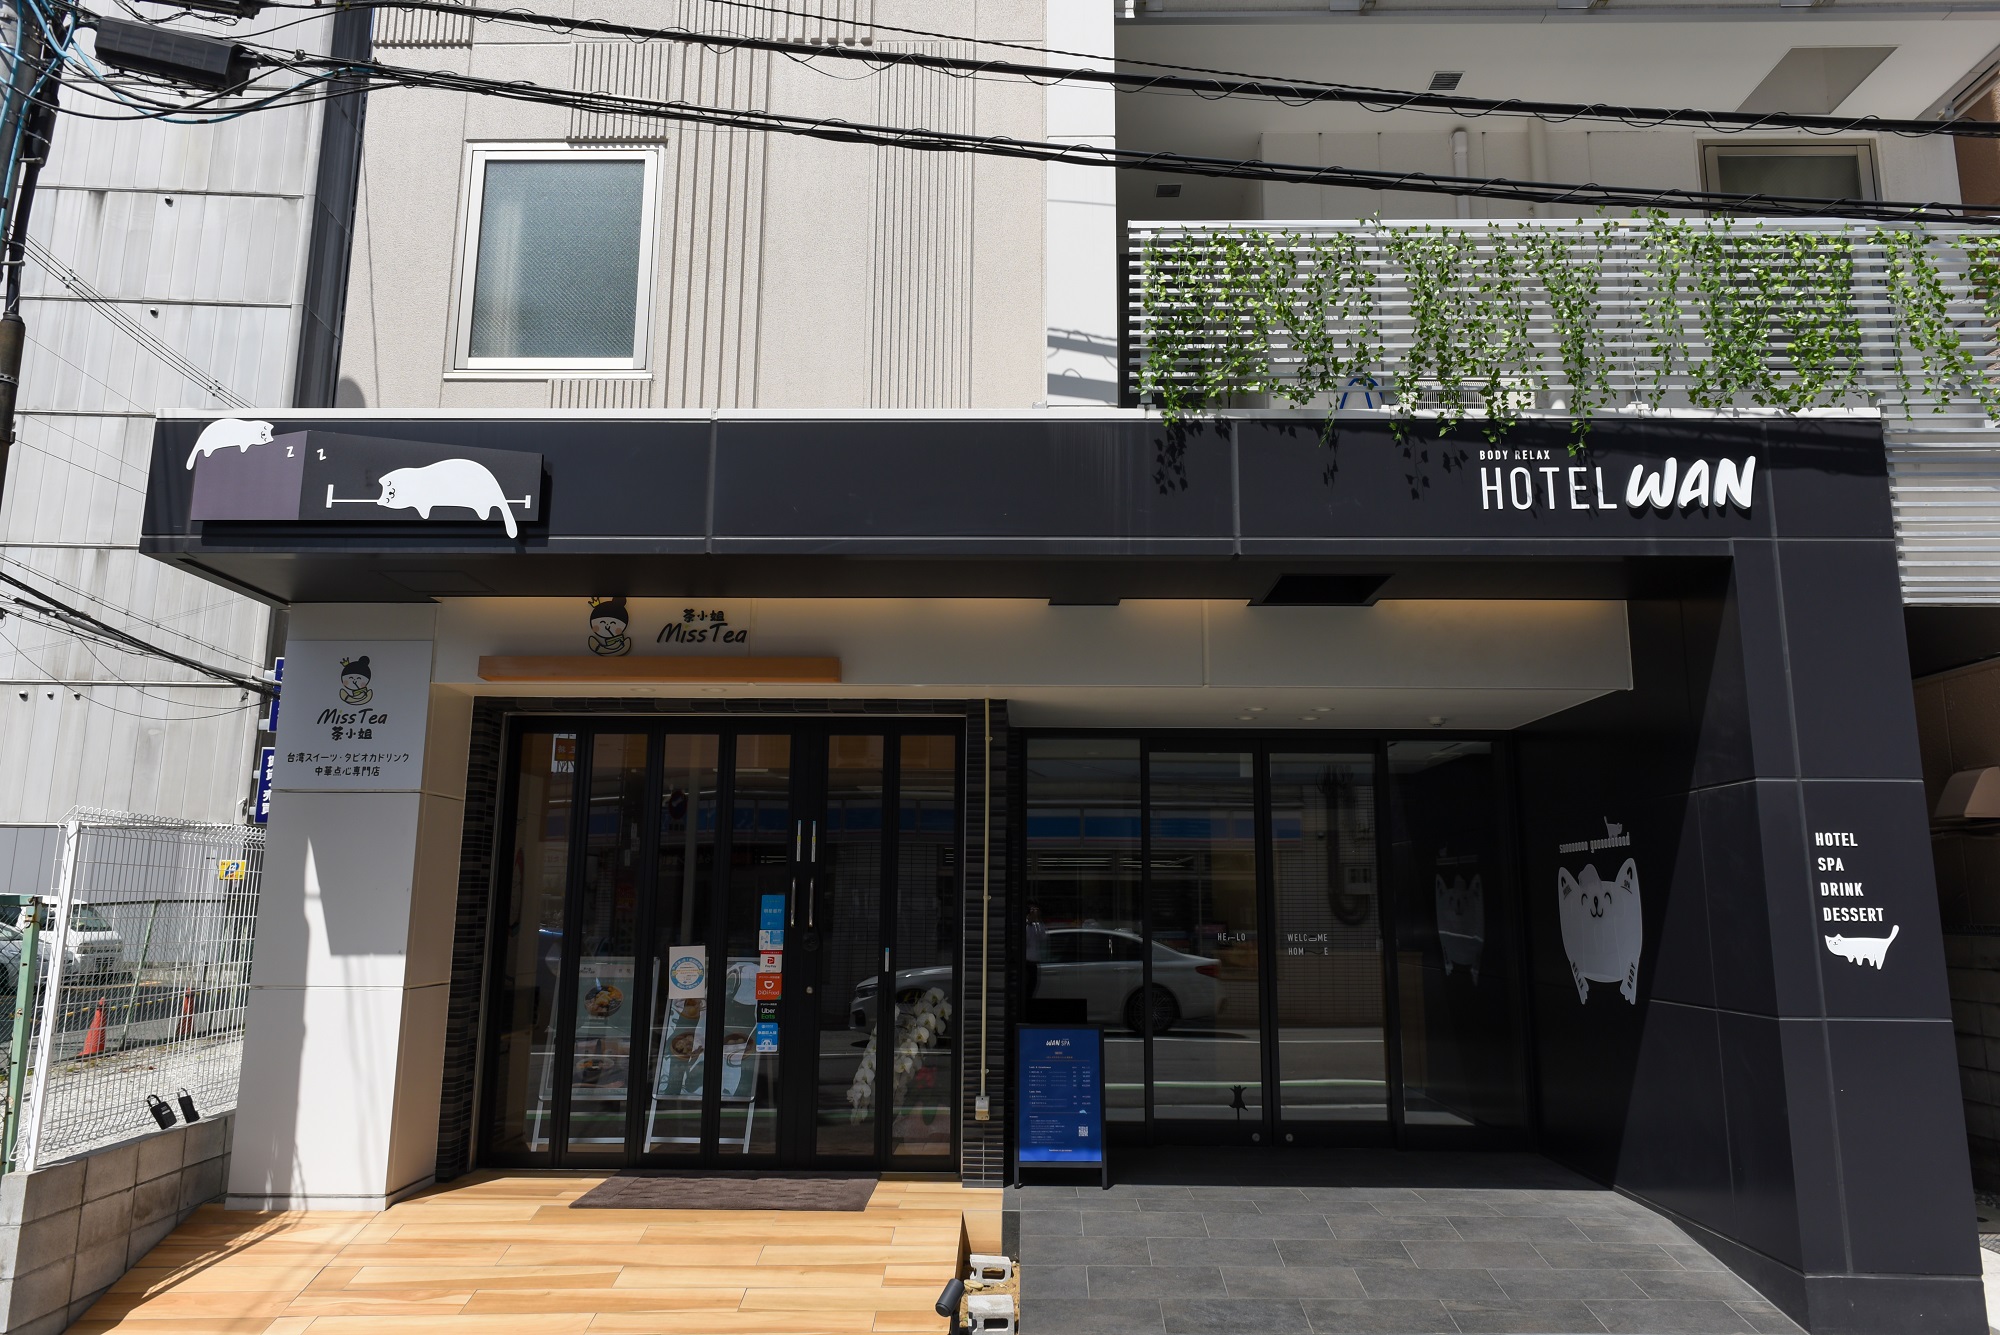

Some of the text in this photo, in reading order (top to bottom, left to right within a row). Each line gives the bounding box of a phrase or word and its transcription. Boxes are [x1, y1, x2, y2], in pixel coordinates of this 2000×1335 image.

[1479, 450, 1551, 460] BODY RELAX
[1480, 455, 1756, 510] HOTEL WAN
[683, 608, 725, 622] 茶小姐
[332, 726, 373, 741] 茶小姐
[315, 766, 381, 777] 中華点心専門店
[1815, 832, 1859, 847] HOTEL
[1817, 857, 1844, 871] SPA
[1820, 882, 1864, 896] DRINK
[1823, 907, 1884, 922] DESSERT
[1627, 962, 1636, 989] BODY
